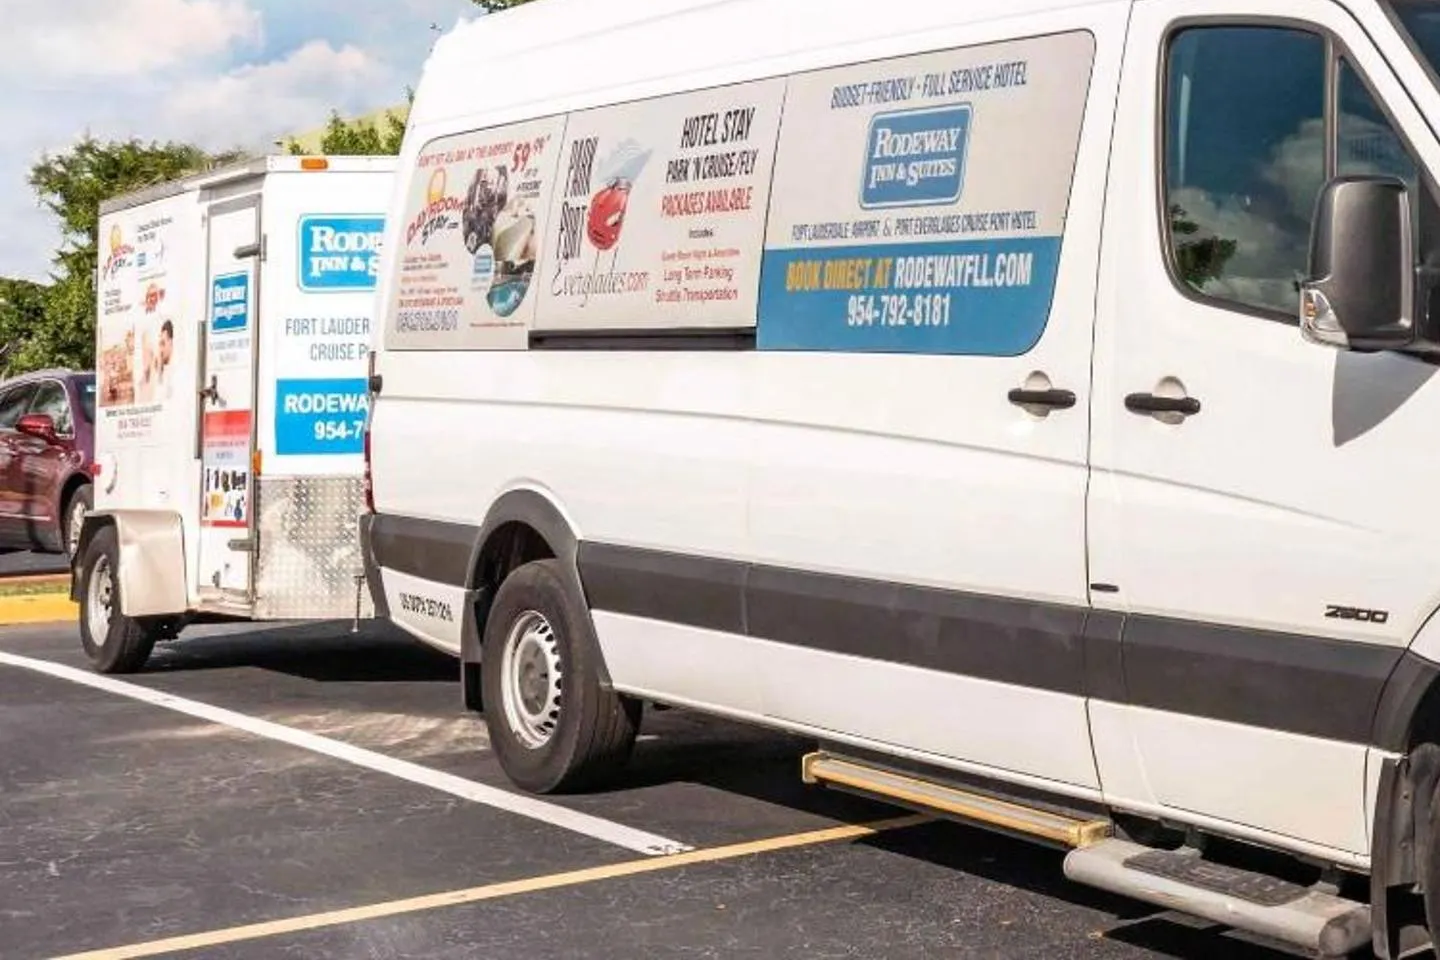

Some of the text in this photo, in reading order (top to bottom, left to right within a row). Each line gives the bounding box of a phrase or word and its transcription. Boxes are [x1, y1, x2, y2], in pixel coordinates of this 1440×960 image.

[949, 64, 993, 93] SERVICE
[993, 61, 1028, 88] HOTEL
[680, 107, 755, 149] HOTEL STAY
[873, 127, 961, 158] RODEWAY
[666, 158, 690, 183] PARK
[869, 163, 896, 189] INN
[906, 158, 957, 186] SUITES
[661, 186, 753, 217] PACKAGES AVAILABLE
[883, 216, 892, 236] &
[787, 253, 1033, 292] BOOK DIRECT AT RODEWAYFLL.COM
[848, 294, 950, 326] 954-792-8181
[285, 318, 318, 336] FORT
[310, 343, 355, 361] CRUISE
